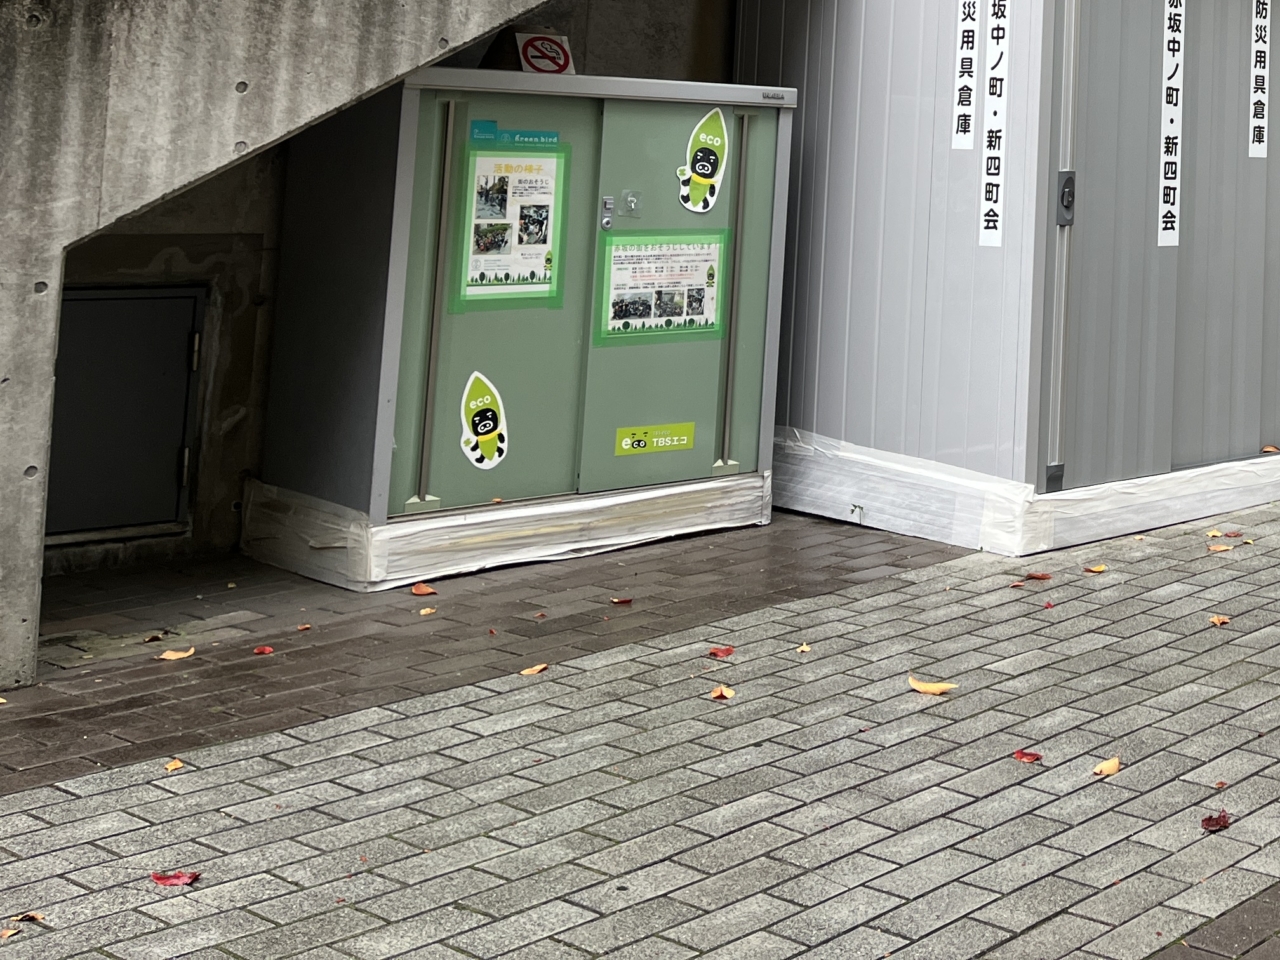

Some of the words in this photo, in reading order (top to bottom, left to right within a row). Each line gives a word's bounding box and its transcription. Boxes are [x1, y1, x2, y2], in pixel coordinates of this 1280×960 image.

[1252, 0, 1269, 145] 防災用具倉庫
[699, 133, 721, 146] eco
[493, 163, 543, 175] 活動の様子
[469, 395, 491, 409] eco
[652, 436, 688, 447] TBSエコ
